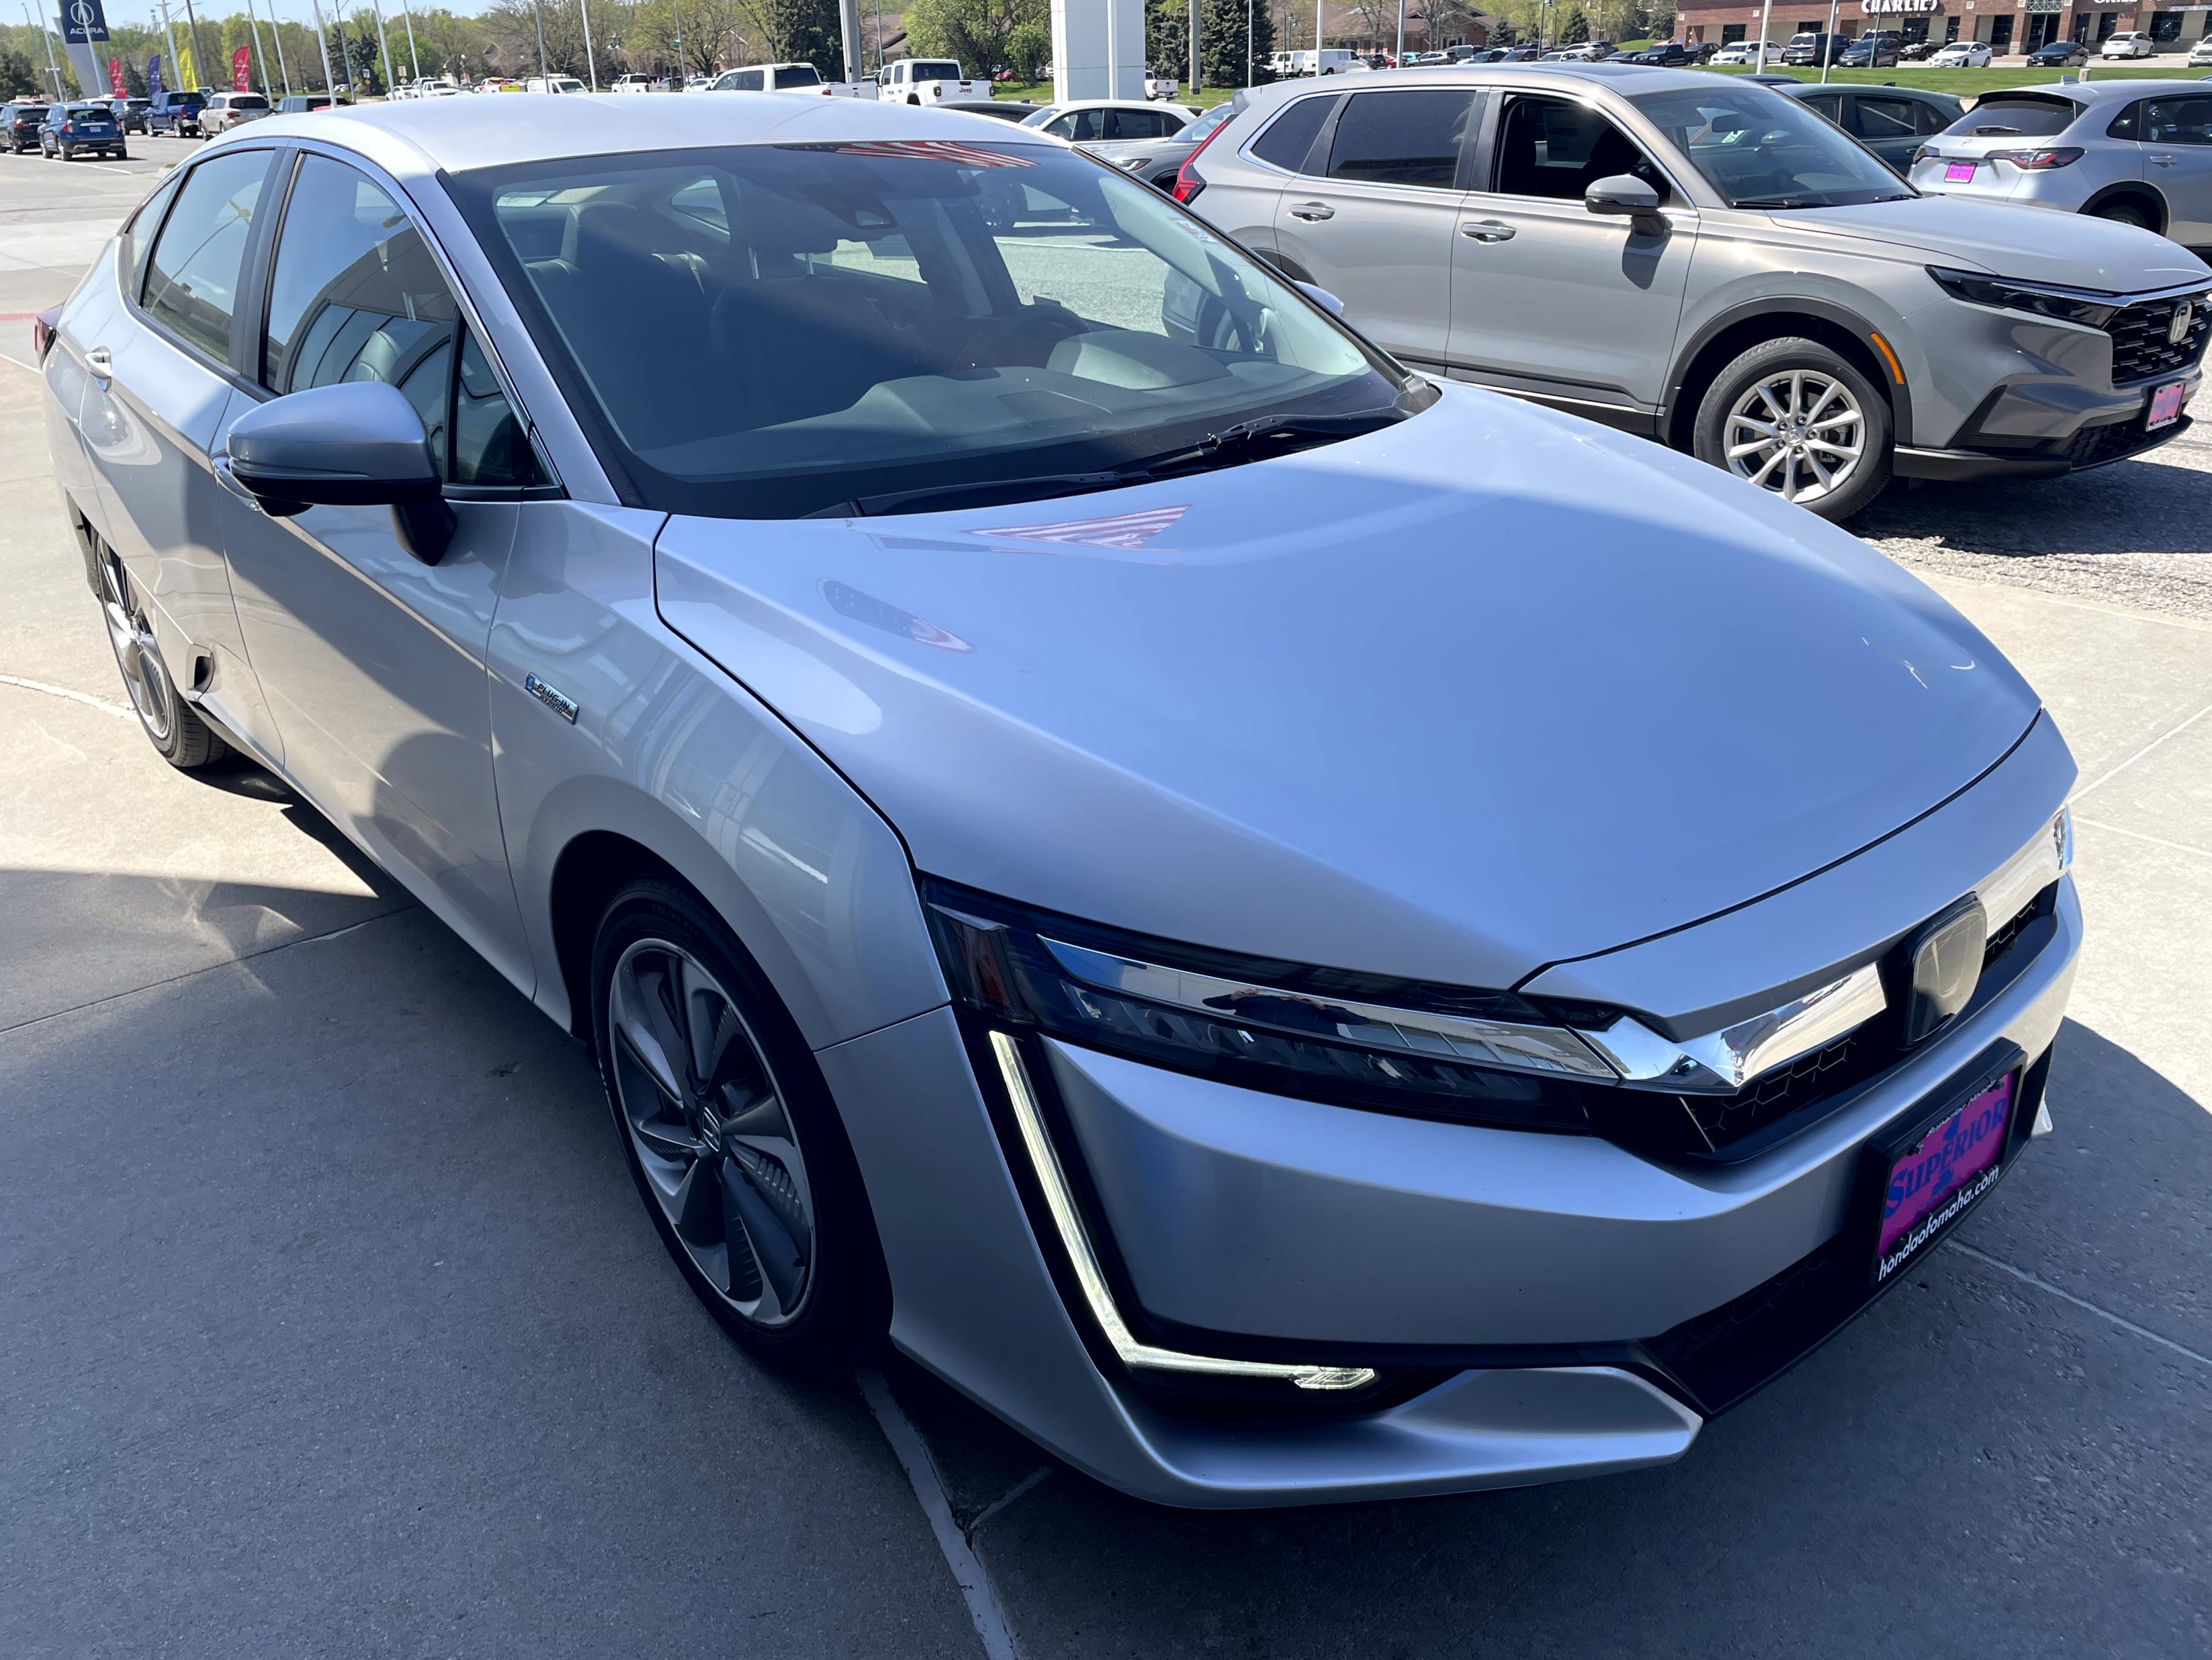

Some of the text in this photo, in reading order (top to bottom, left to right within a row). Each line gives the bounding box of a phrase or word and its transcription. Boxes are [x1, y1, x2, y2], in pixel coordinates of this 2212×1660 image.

[537, 683, 570, 710] PLUG-IN
[1884, 1097, 2007, 1219] SUPERIOR
[1878, 1166, 1999, 1281] hondaofomaha.com
